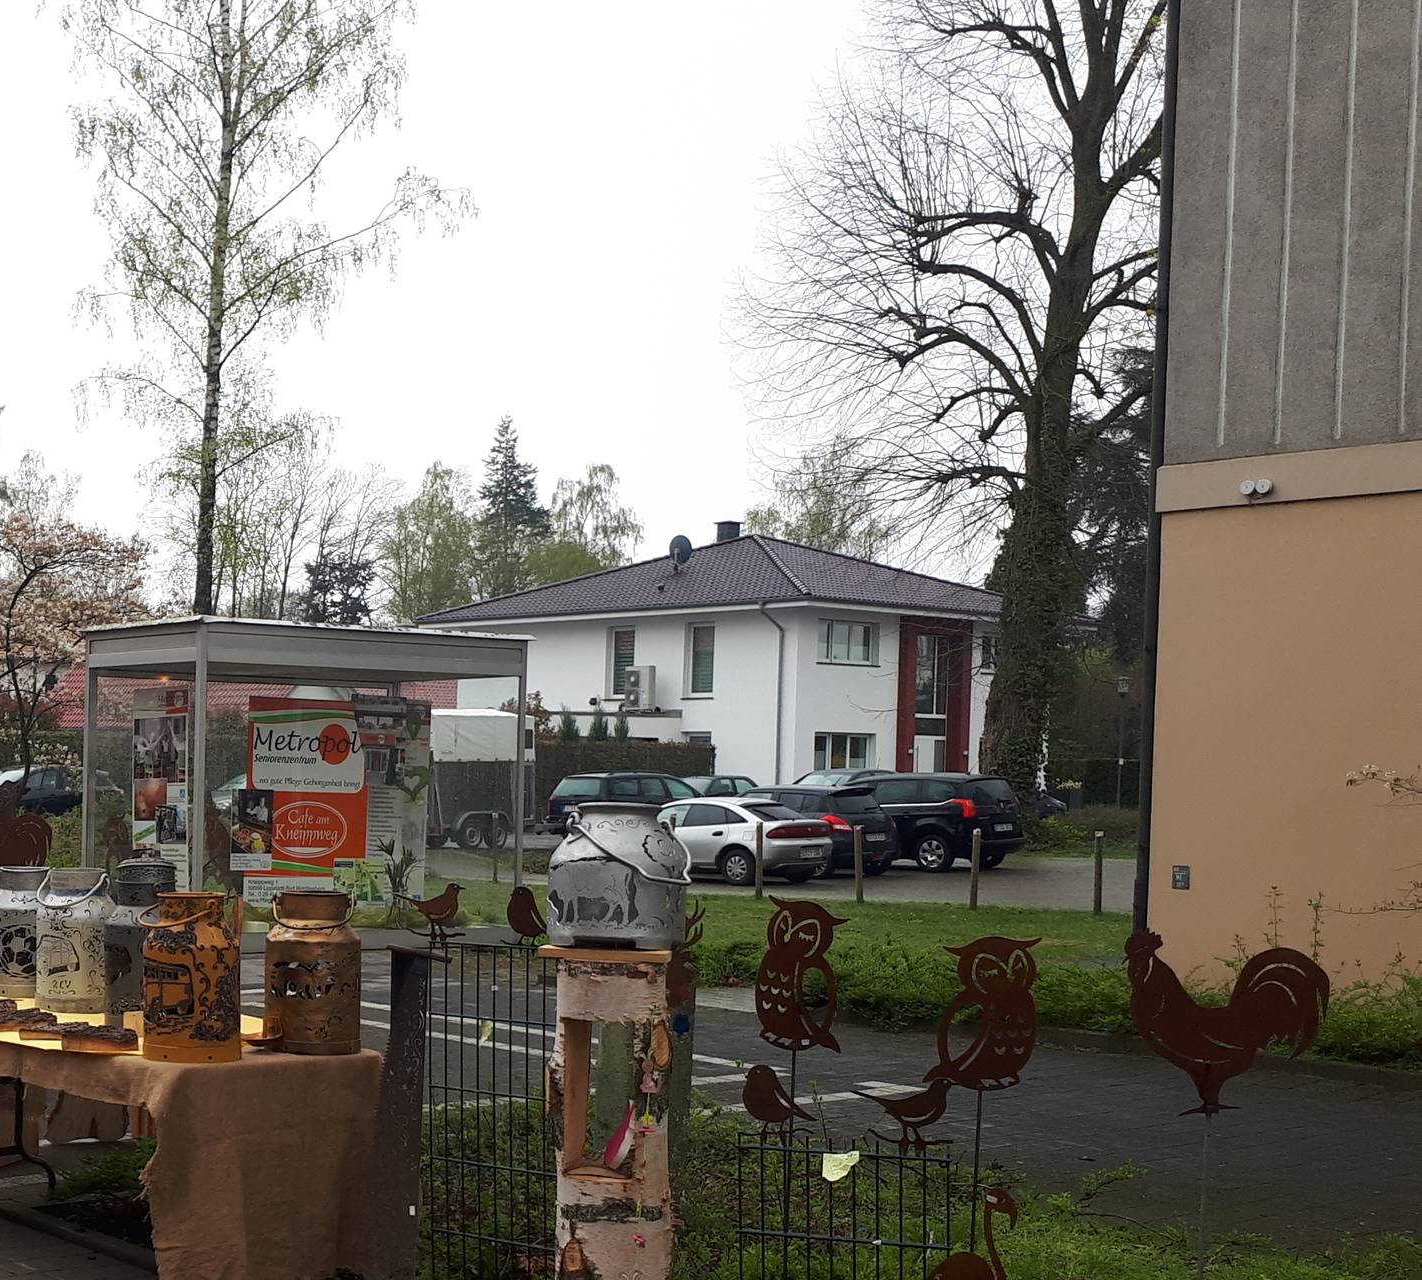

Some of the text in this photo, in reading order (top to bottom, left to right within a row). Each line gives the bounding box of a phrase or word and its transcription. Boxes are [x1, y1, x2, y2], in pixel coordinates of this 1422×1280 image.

[254, 726, 362, 761] Metropol
[254, 753, 317, 765] Seniorenzentrum
[315, 815, 330, 825] am
